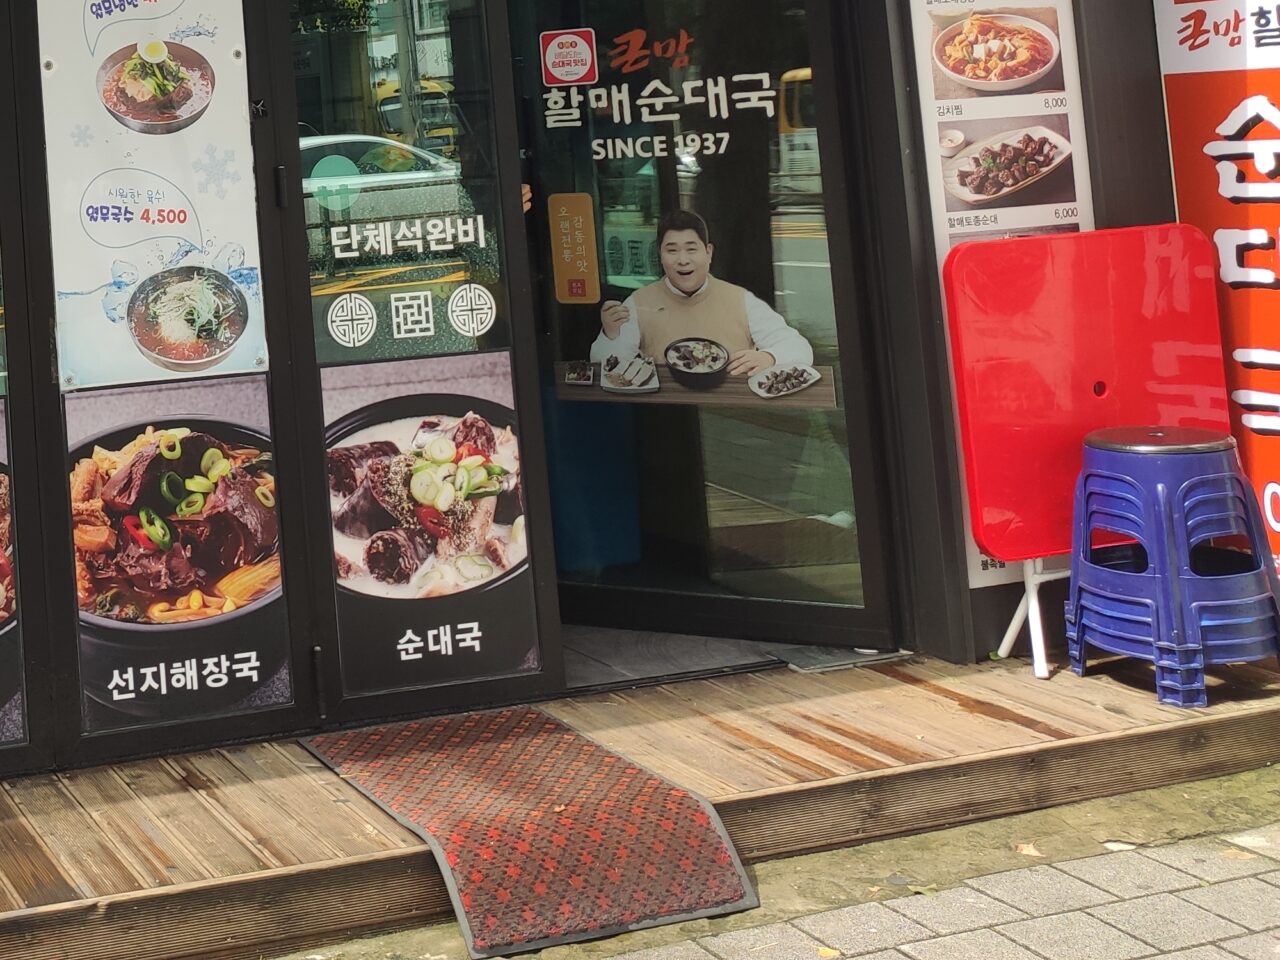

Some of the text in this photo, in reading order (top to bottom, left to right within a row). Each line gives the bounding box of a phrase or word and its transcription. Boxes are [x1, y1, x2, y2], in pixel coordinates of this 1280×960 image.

[608, 28, 695, 70] 큰맘
[1177, 8, 1246, 53] 큰맘
[543, 72, 777, 129] 할매순대국
[936, 98, 1067, 117] 김치찜 8,000
[592, 132, 730, 161] SINCE 1937
[85, 205, 188, 225] 열무국수 4,500
[108, 187, 166, 205] 시원한 육수!
[330, 214, 487, 259] 단체석완비
[947, 207, 1078, 229] 할매토종순대 6,000
[396, 622, 483, 662] 순대국
[107, 651, 261, 703] 선지해장국
